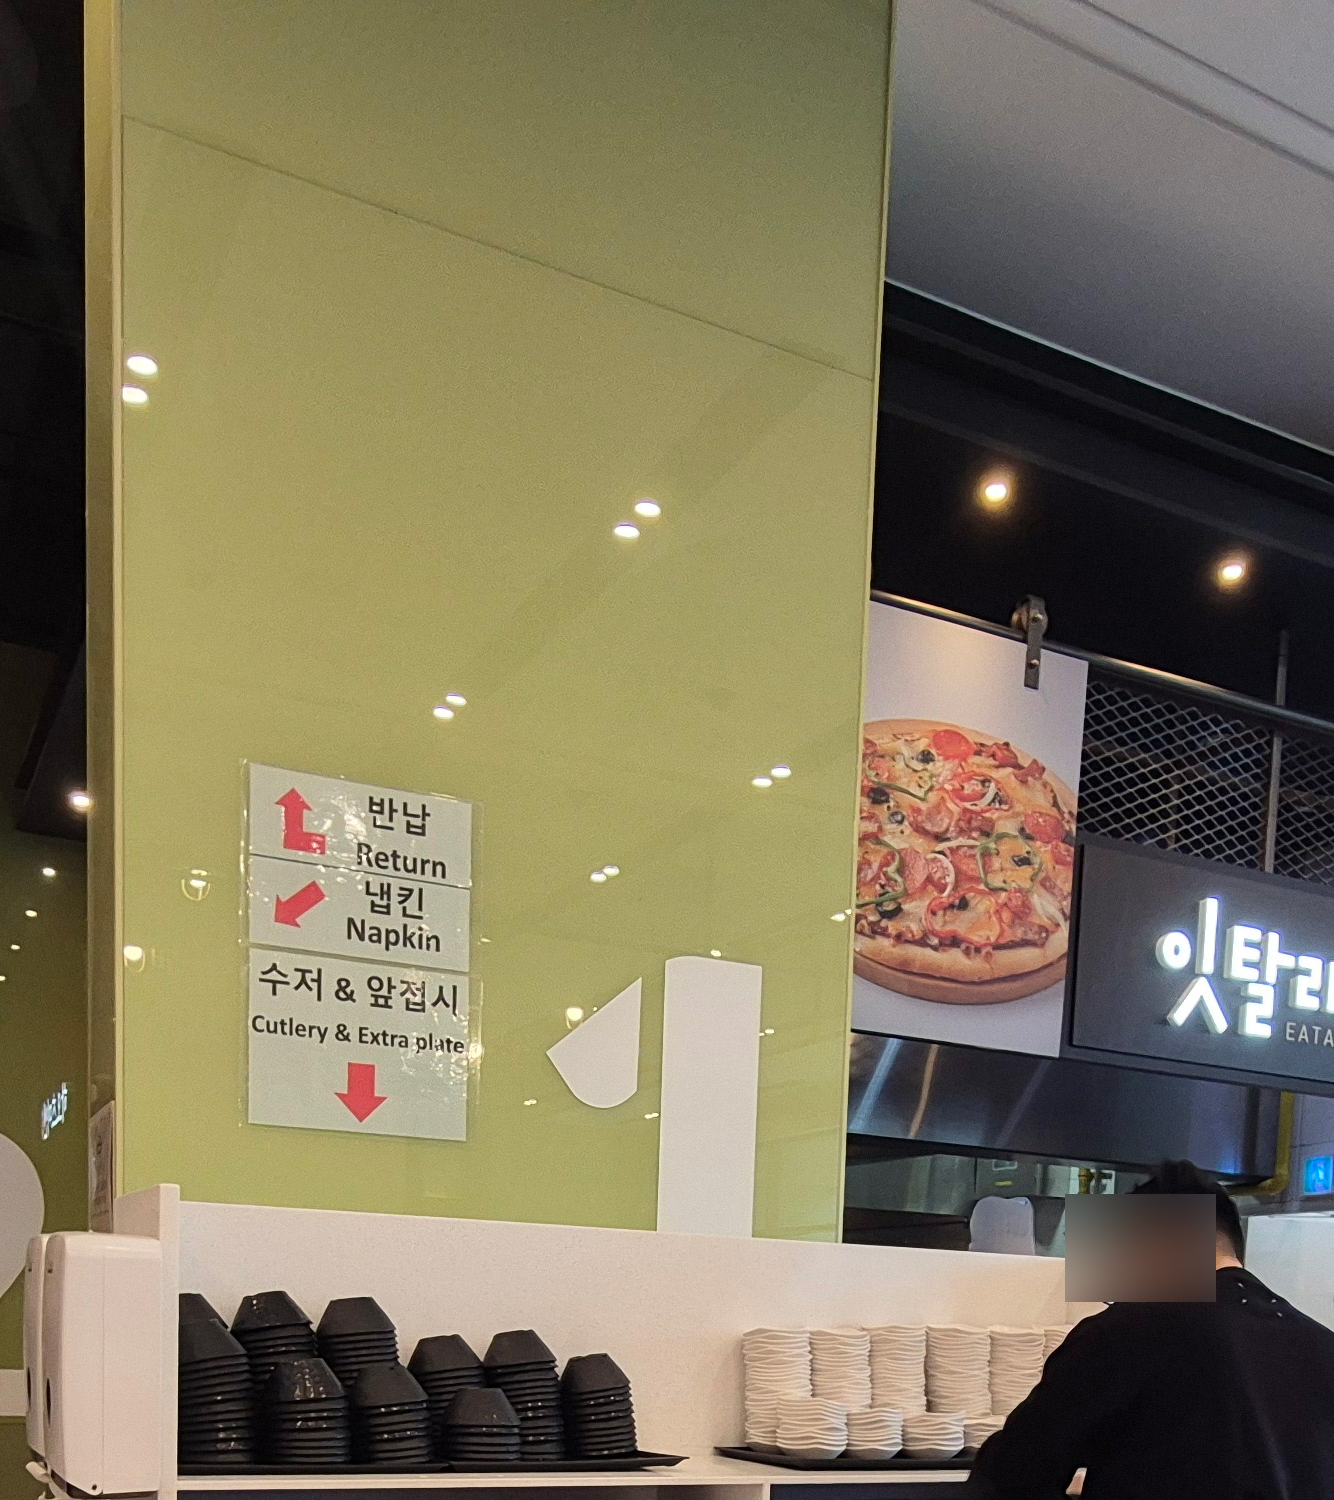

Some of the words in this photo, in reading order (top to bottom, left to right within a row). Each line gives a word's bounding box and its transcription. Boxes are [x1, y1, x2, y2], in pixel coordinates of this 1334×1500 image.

[367, 795, 431, 837] 반납
[356, 841, 447, 880] Return
[364, 880, 425, 921] 냅킨
[346, 916, 441, 953] Napkin
[257, 962, 324, 1003] 수저
[334, 977, 356, 1003] &
[366, 975, 459, 1017] 앞접시
[250, 1014, 328, 1045] Cutlery
[334, 1022, 352, 1044] &
[357, 1026, 410, 1050] Extra
[414, 1029, 465, 1056] plate
